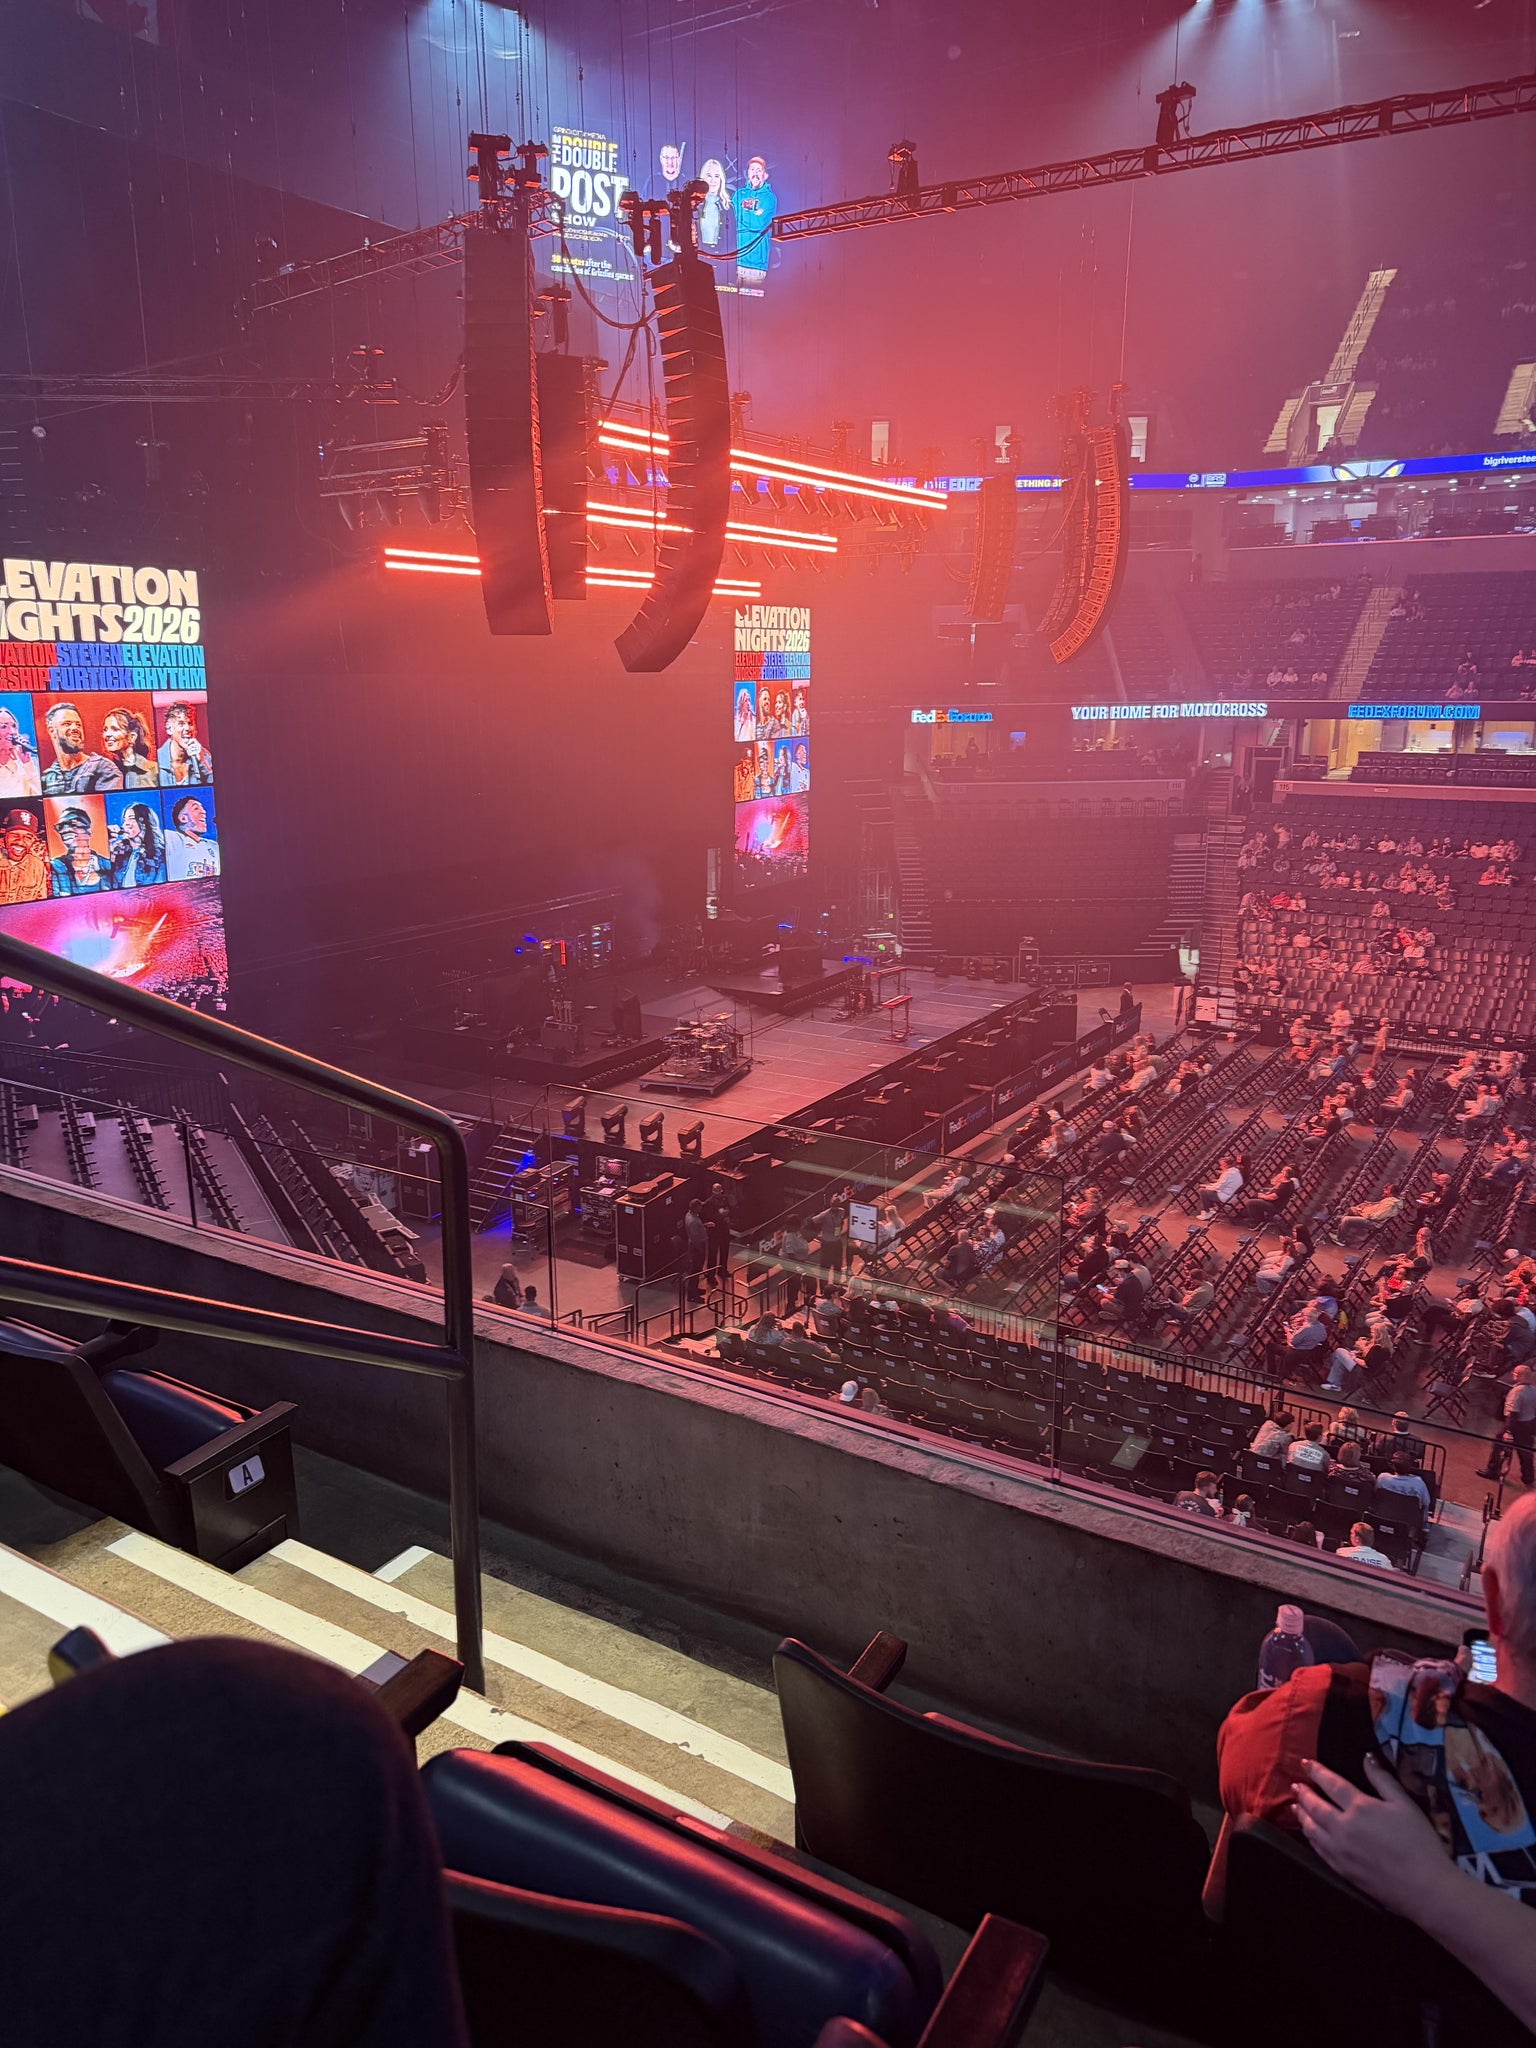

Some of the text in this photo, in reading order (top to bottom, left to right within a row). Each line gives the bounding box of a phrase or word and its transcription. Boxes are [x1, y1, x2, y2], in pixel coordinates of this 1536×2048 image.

[552, 134, 561, 163] THE
[0, 558, 199, 607] EVATION
[122, 605, 200, 644] 2026
[734, 628, 810, 653] NIGHTS 2026
[56, 642, 123, 667] STEVEN
[122, 644, 206, 668] ELEVATION
[49, 667, 134, 691] FURTICK
[132, 668, 207, 690] RHYTHM
[1071, 703, 1268, 719] YOUR HOME FOR MOTOCROSS
[1347, 704, 1481, 720] FEDEXFORUM.COM
[242, 1464, 254, 1486] A
